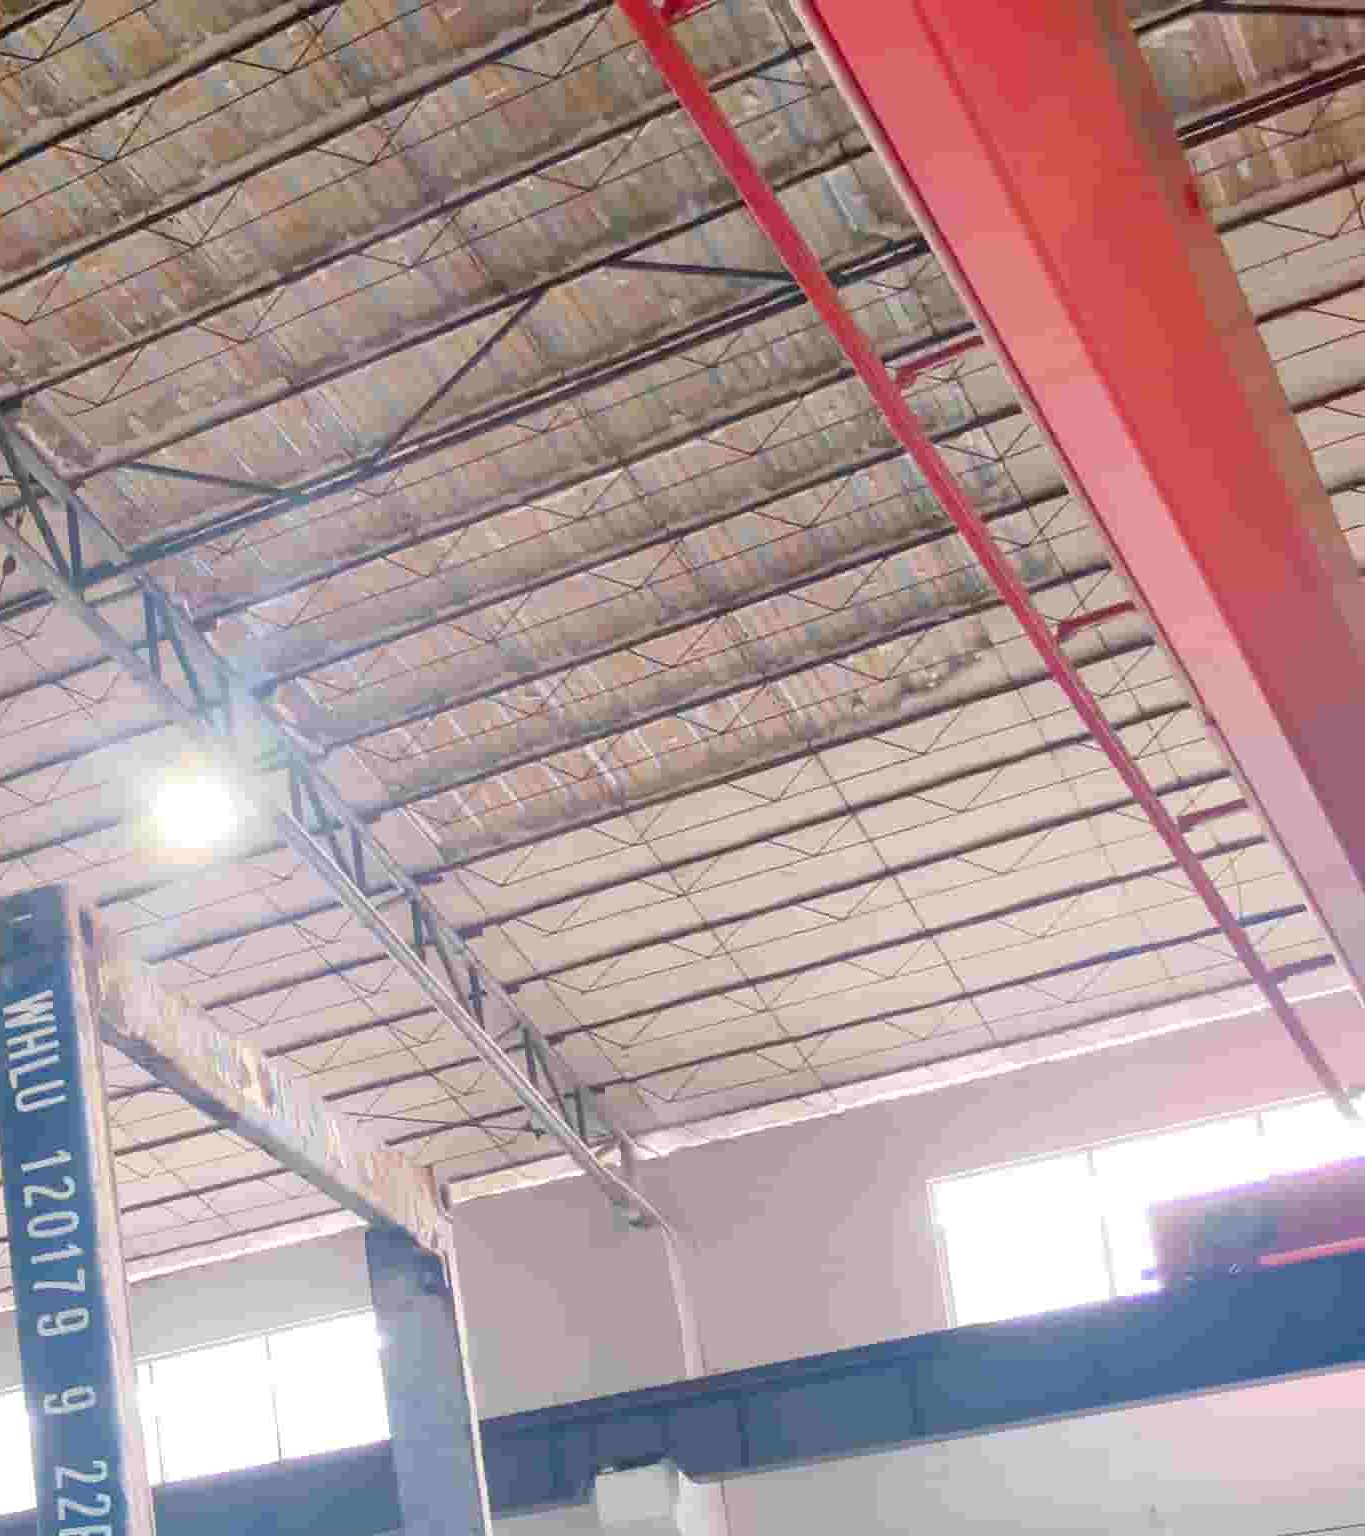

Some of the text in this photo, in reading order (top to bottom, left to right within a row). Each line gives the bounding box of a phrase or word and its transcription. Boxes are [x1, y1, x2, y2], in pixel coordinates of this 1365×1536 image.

[2, 989, 68, 1112] WHLU
[20, 1149, 92, 1337] 120179
[43, 1384, 97, 1415] 9
